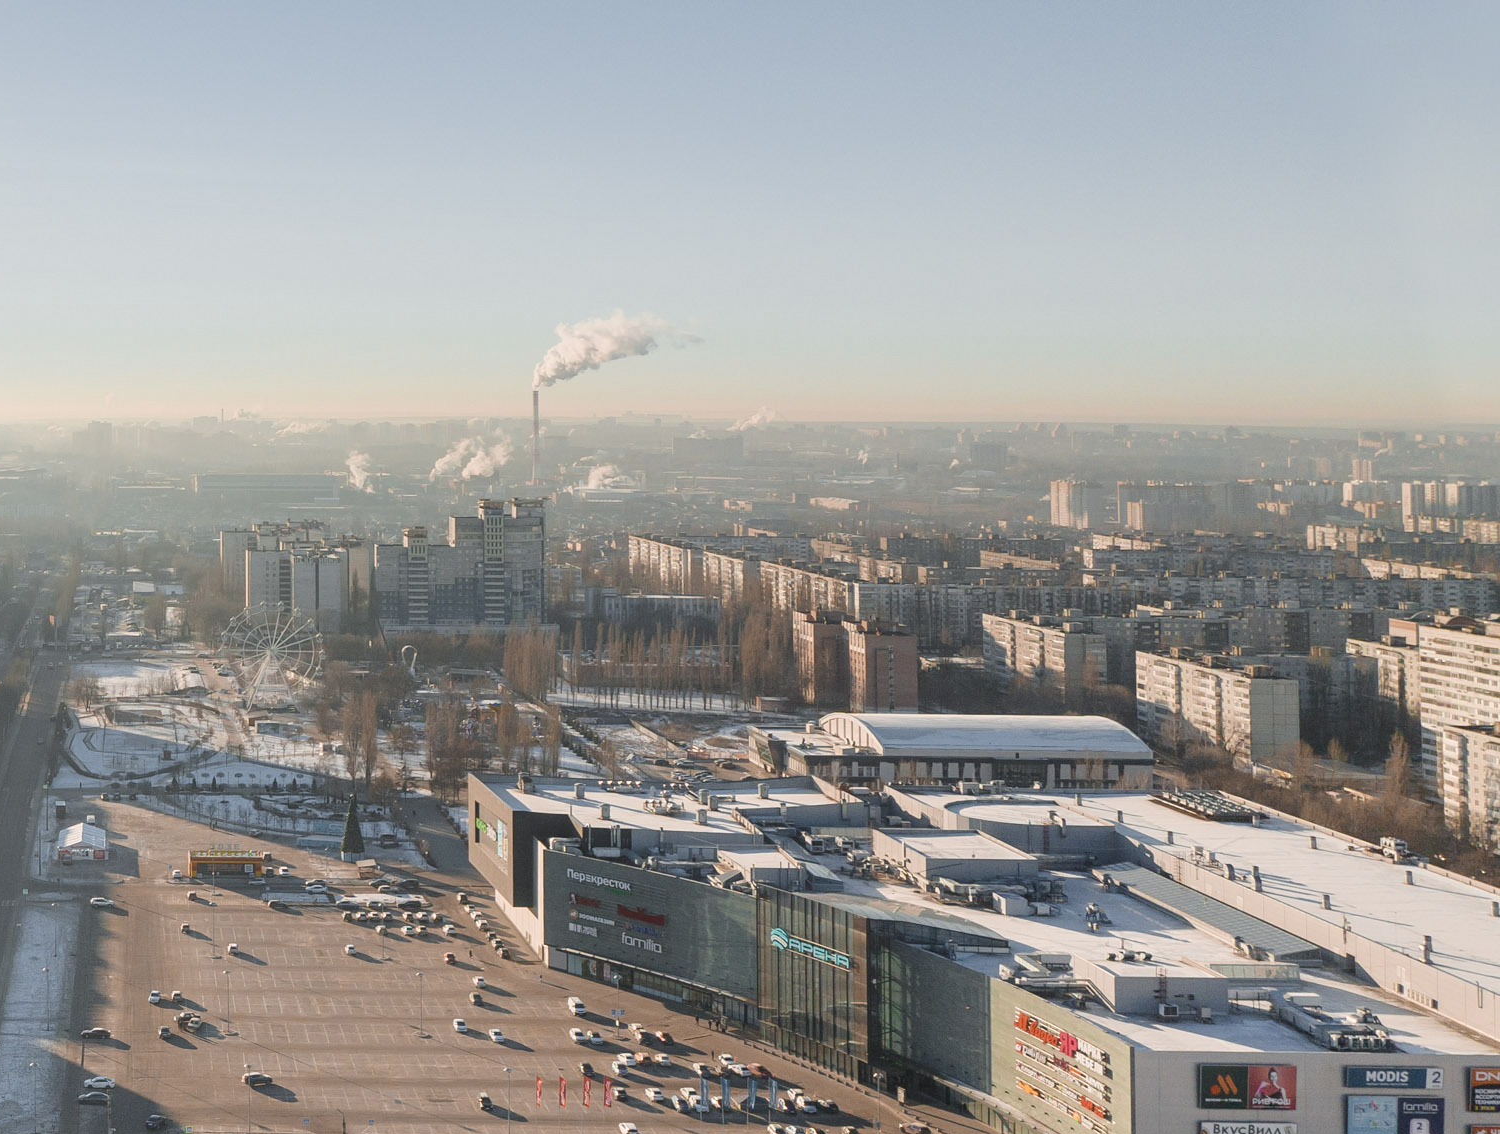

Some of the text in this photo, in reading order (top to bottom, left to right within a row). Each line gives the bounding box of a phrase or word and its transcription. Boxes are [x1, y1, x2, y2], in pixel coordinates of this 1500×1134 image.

[567, 868, 631, 891] Перекресток
[621, 932, 662, 954] familia
[789, 938, 849, 969] АРЕНА
[1366, 1071, 1442, 1084] MODIS 2
[1403, 1102, 1438, 1111] familia
[1417, 1123, 1423, 1131] 2
